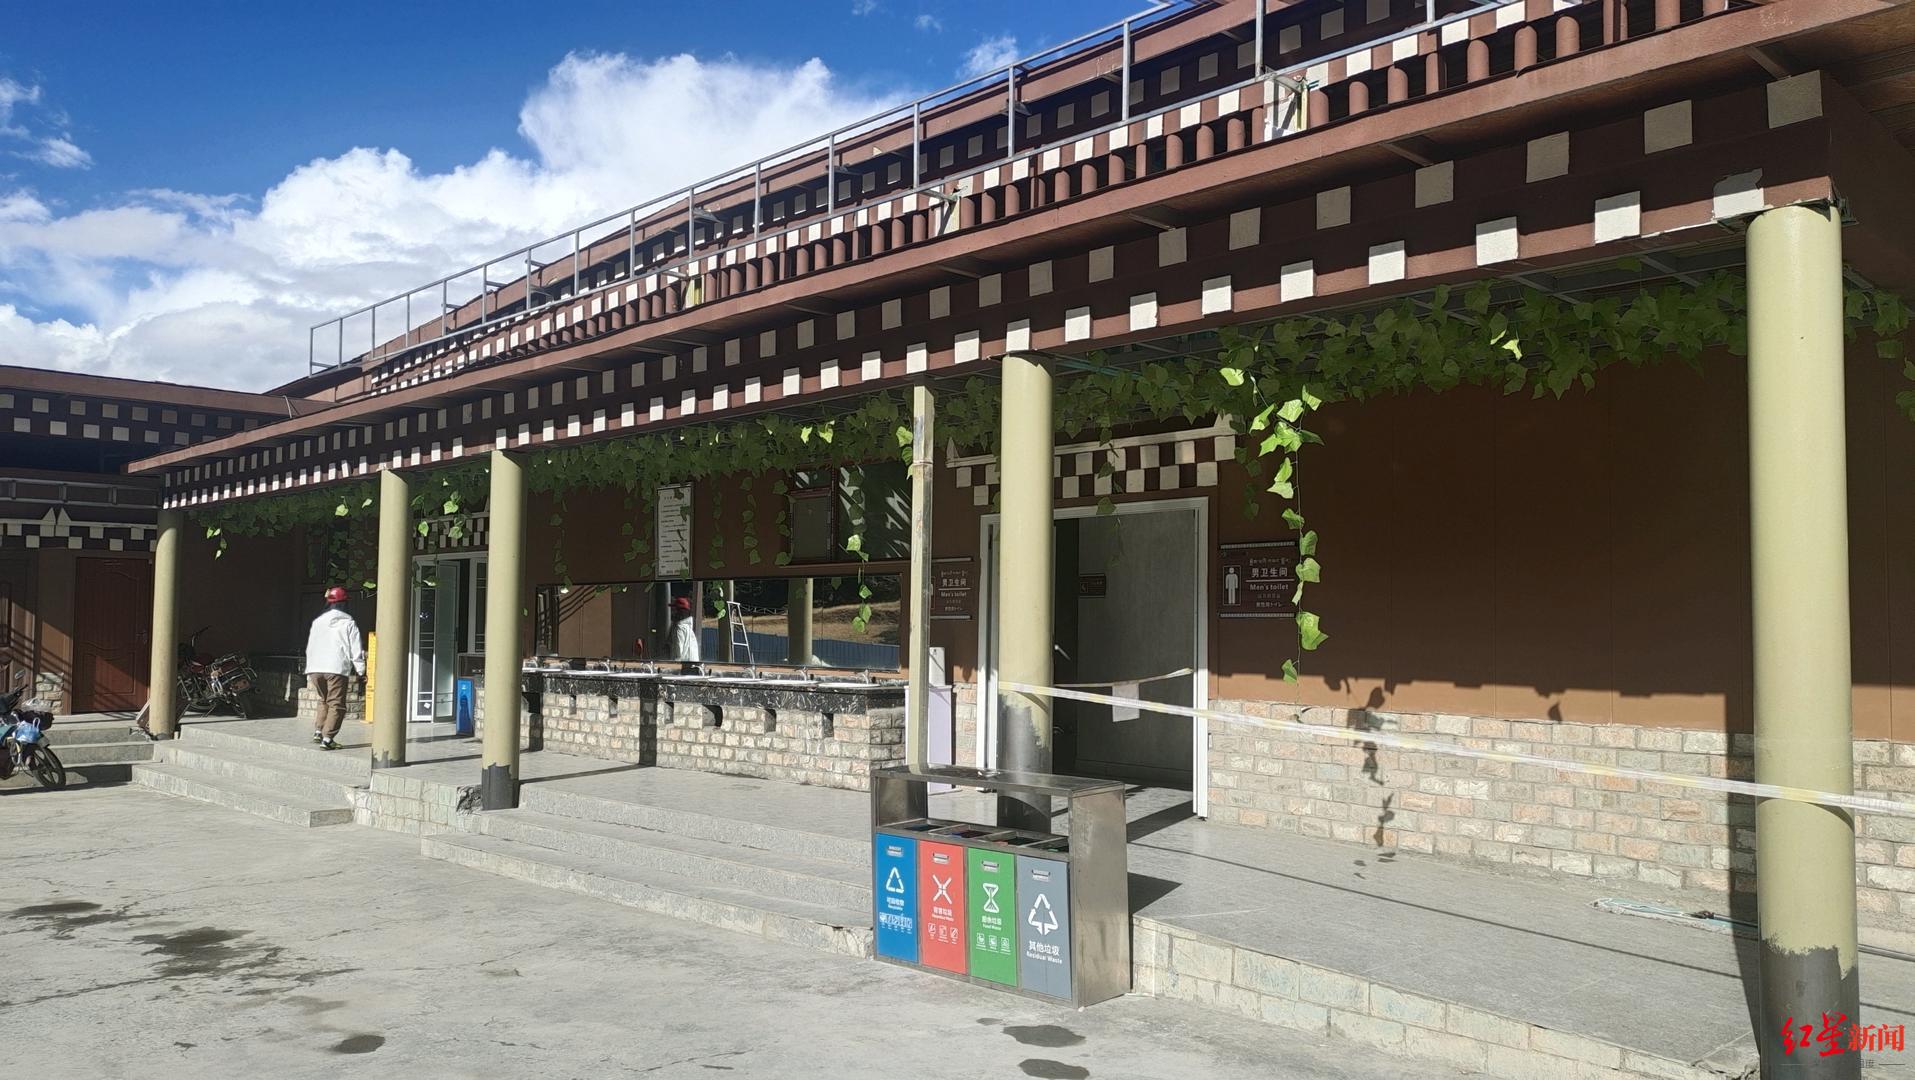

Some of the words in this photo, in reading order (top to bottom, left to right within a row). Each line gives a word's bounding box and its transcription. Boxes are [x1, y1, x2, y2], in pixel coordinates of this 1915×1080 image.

[1252, 567, 1288, 578] 男卫生间
[1029, 940, 1060, 956] 其他垃圾
[1047, 955, 1062, 965] Waste
